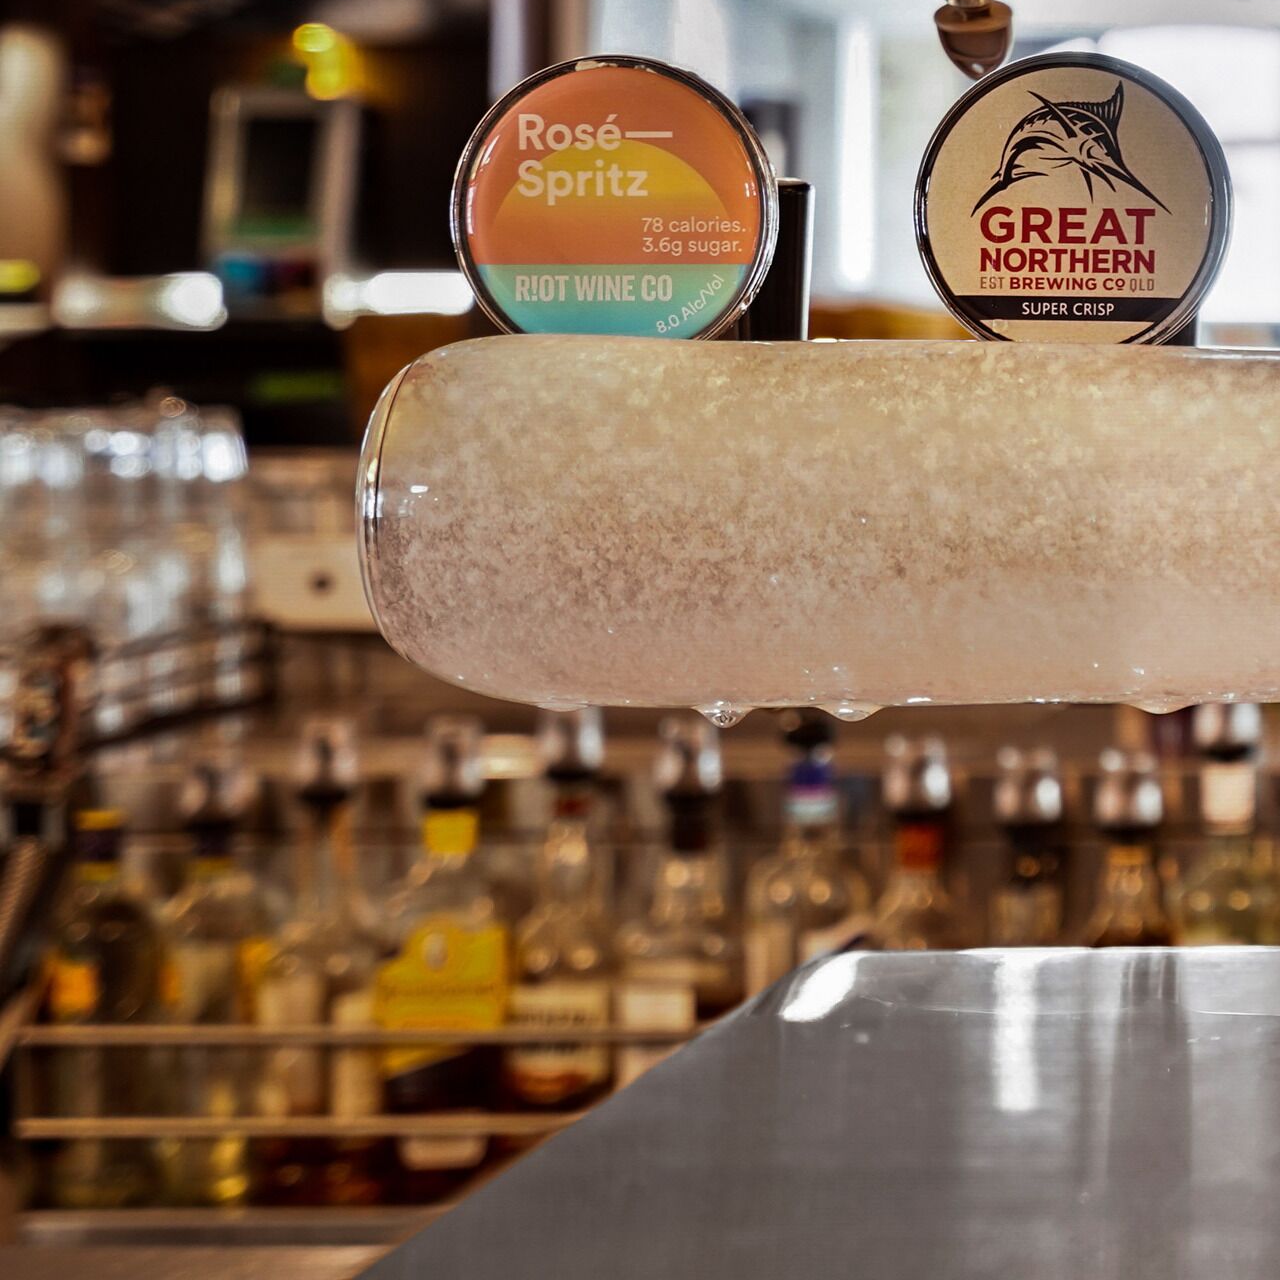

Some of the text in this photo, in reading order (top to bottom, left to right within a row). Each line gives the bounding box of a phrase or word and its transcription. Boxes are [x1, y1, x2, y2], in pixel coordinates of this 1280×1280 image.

[516, 159, 649, 206] Spritz
[642, 216, 747, 233] 78 calories.
[980, 206, 1156, 245] GREAT
[642, 237, 743, 257] 3.6g sugar.
[979, 247, 1156, 274] NORTHERN
[574, 274, 636, 302] WINE
[641, 274, 673, 302] CO
[979, 276, 1005, 290] EST
[1009, 277, 1098, 291] BREWING
[1129, 278, 1155, 293] QLD
[656, 273, 725, 333] 8.0 Alc/Vol
[1021, 302, 1115, 317] SUPER CRISP
